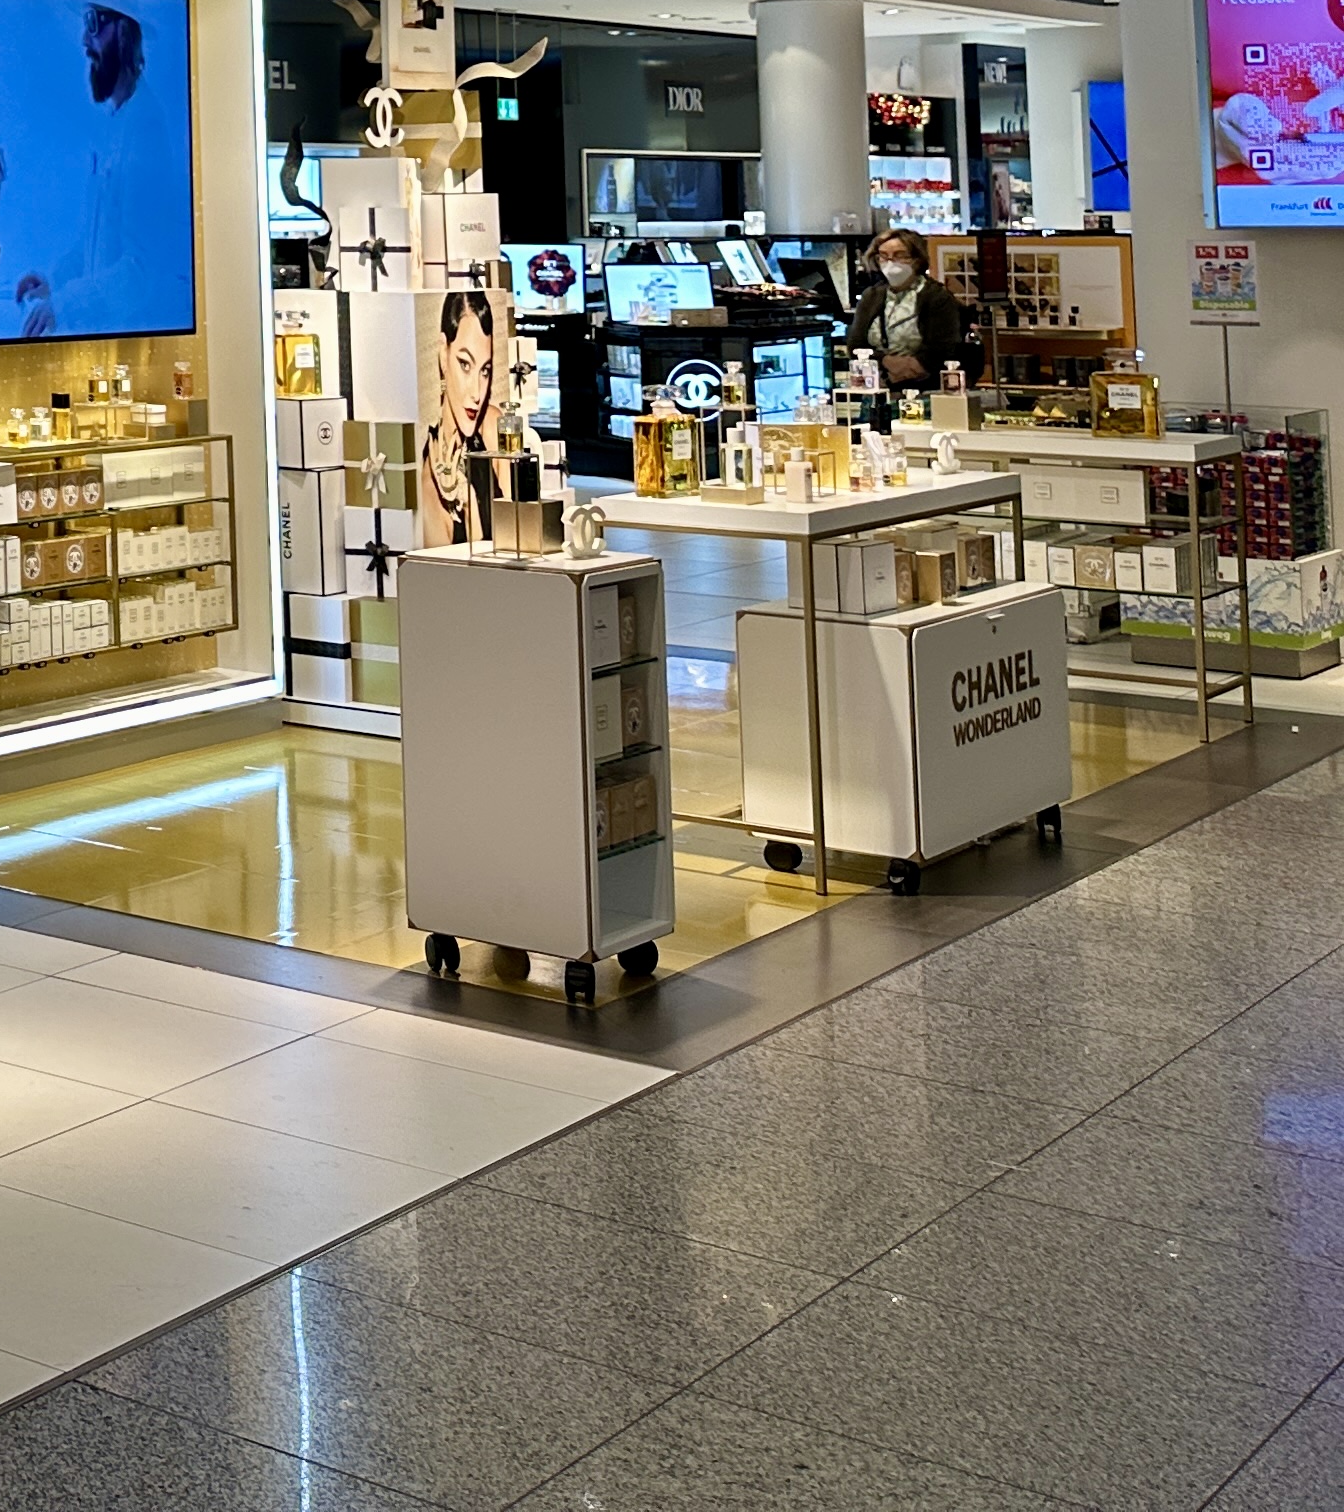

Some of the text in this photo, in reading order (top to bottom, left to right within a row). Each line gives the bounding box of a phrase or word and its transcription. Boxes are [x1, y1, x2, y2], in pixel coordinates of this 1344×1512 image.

[667, 86, 704, 113] DIOR
[283, 502, 292, 559] CHANEL
[951, 649, 1040, 712] CHANEL
[953, 697, 1042, 747] WONDERLAND
